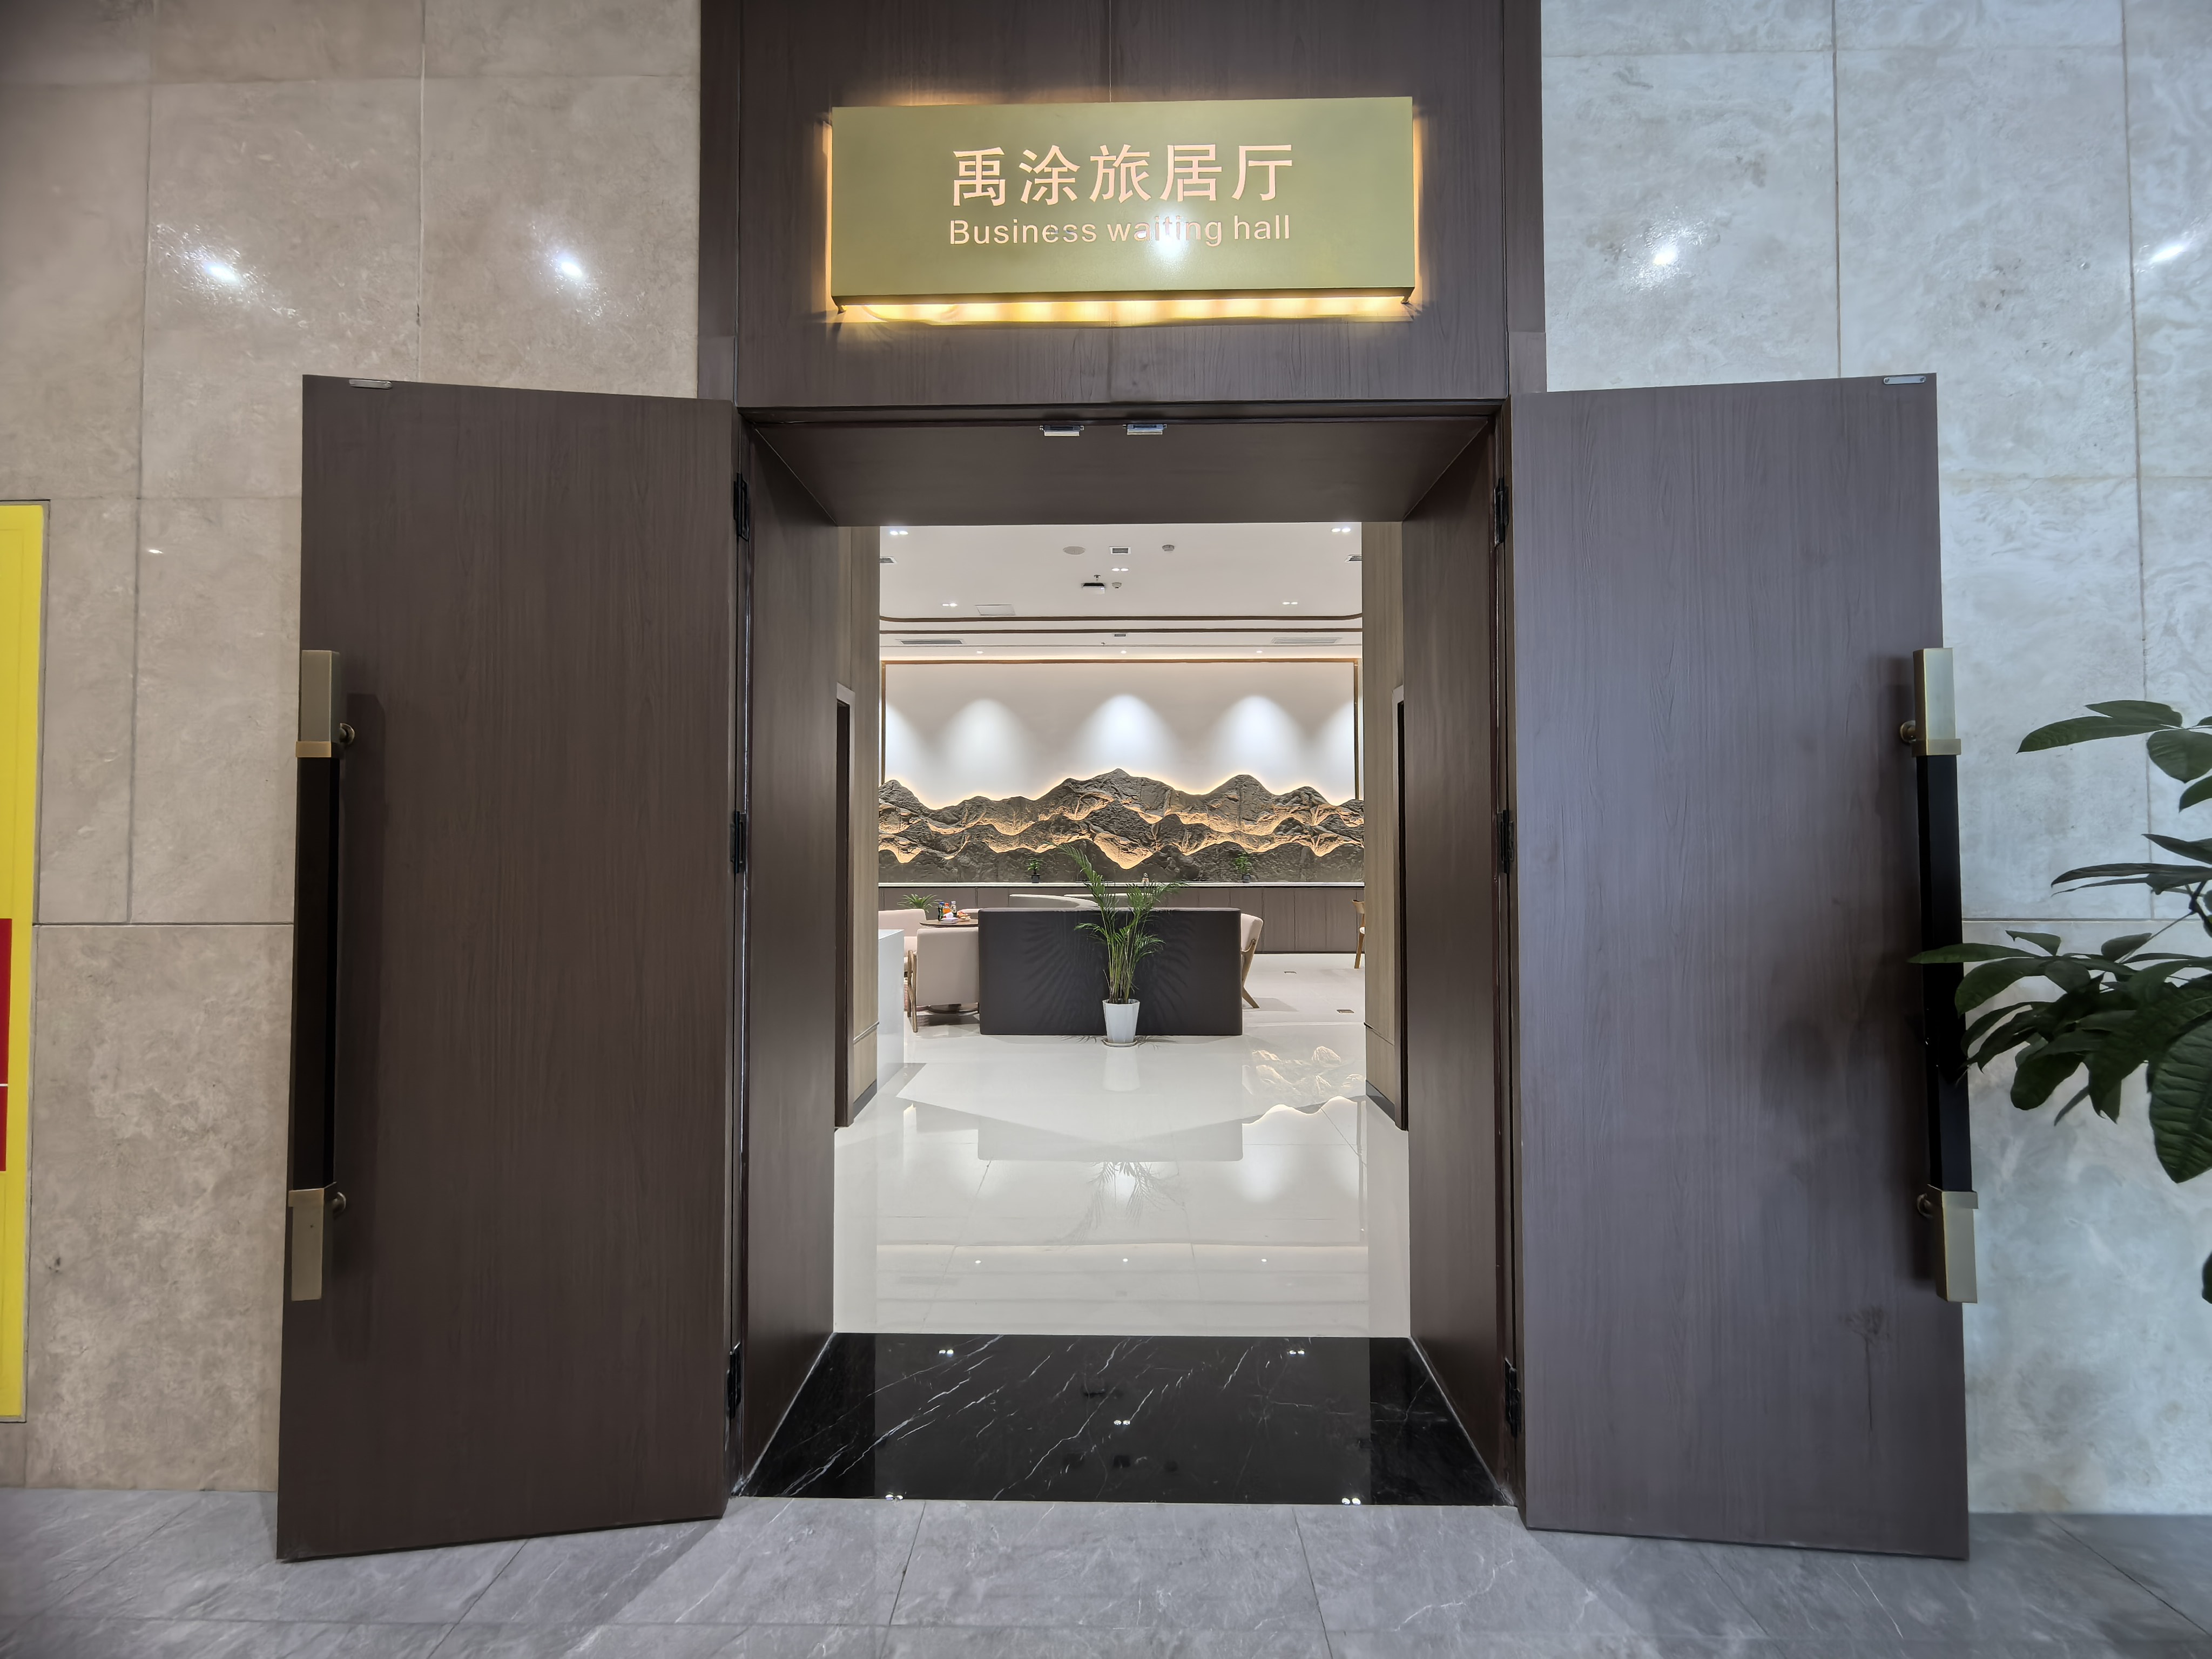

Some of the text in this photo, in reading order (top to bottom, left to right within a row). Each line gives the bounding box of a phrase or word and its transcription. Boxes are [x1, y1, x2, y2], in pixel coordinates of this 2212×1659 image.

[953, 144, 1292, 206] 禹涂旅居厅
[950, 214, 1290, 247] Business waiting hall
